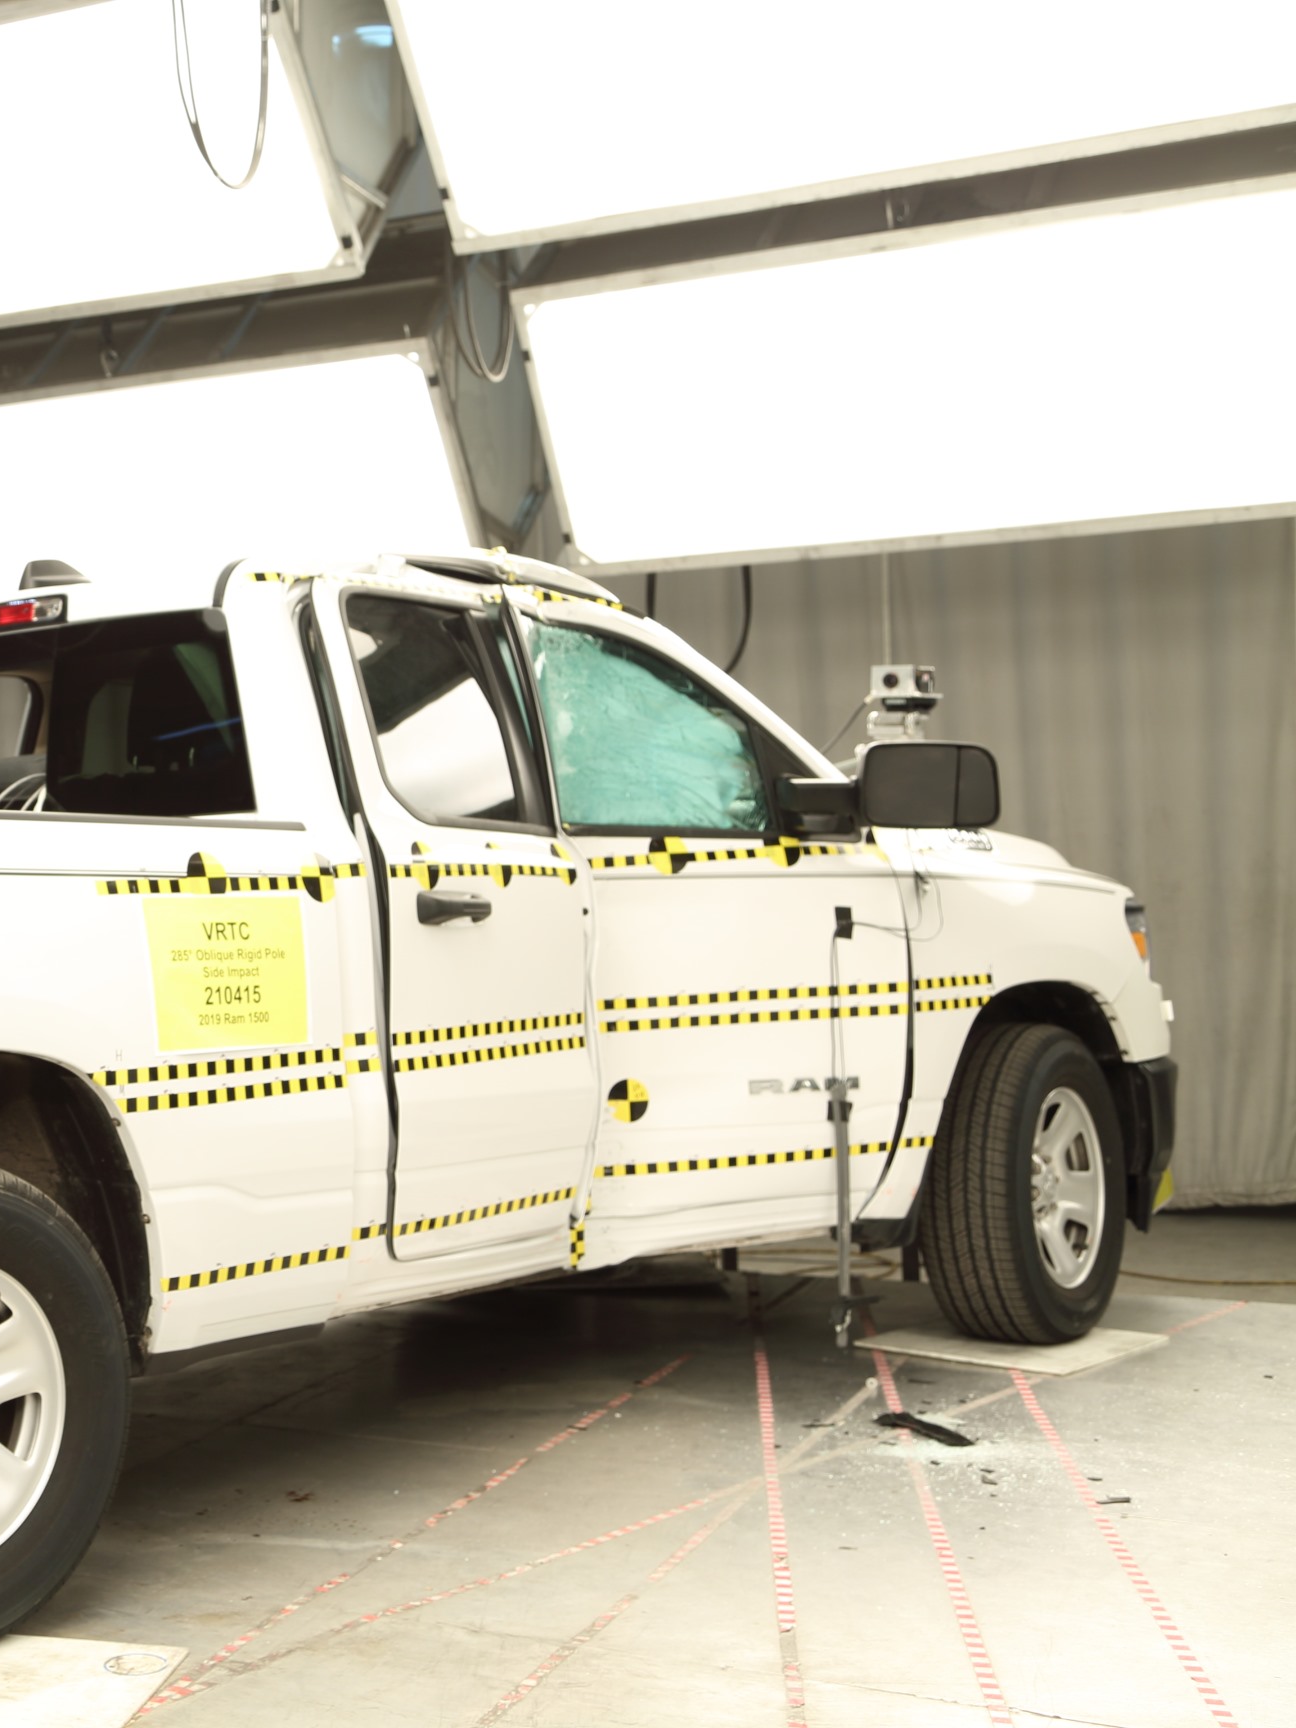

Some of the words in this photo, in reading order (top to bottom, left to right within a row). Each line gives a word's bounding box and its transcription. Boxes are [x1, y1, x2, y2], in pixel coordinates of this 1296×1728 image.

[202, 921, 251, 941] VRTC
[195, 949, 235, 963] Oblique
[237, 948, 263, 963] Rigid
[264, 947, 286, 960] Pole
[203, 966, 225, 979] Side
[227, 966, 260, 979] Impact
[204, 985, 262, 1006] 210415
[199, 1013, 221, 1026] 2019
[223, 1012, 246, 1025] Ram
[248, 1011, 270, 1023] 1500
[748, 1076, 860, 1096] RAM
